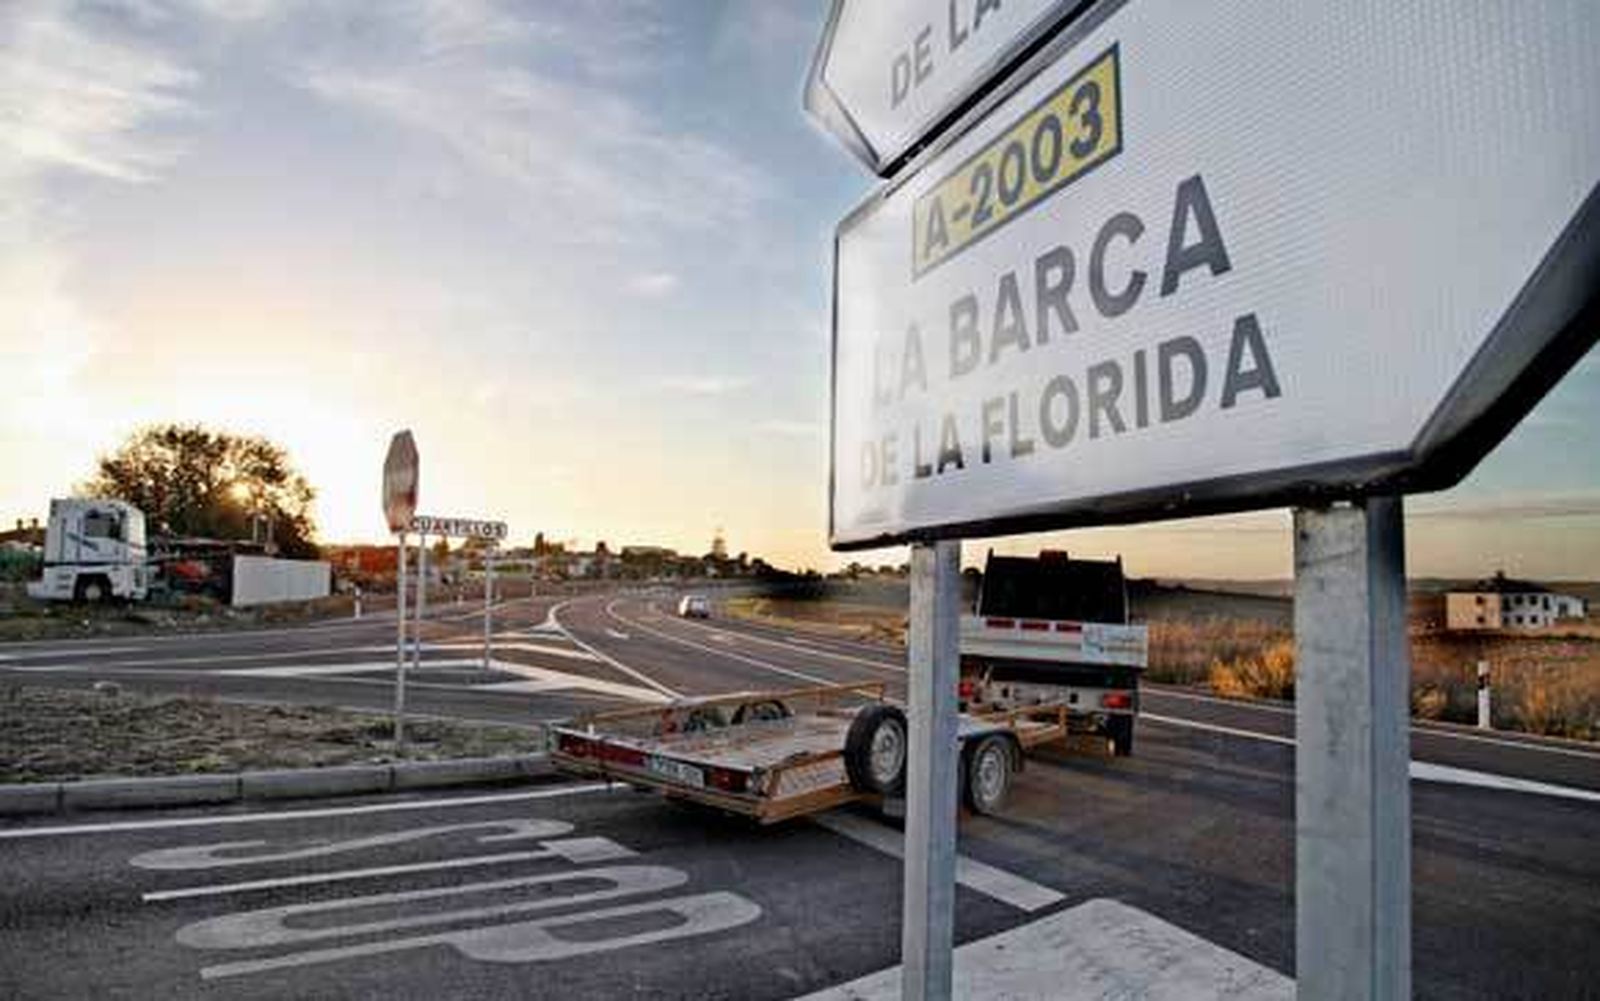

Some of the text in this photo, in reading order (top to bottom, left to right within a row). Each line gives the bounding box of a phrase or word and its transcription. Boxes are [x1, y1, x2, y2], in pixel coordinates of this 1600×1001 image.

[891, 24, 934, 110] DE
[924, 80, 1103, 259] A-2003
[873, 174, 1232, 406] LA BARCA
[860, 312, 1282, 490] DE LA FLORIDA
